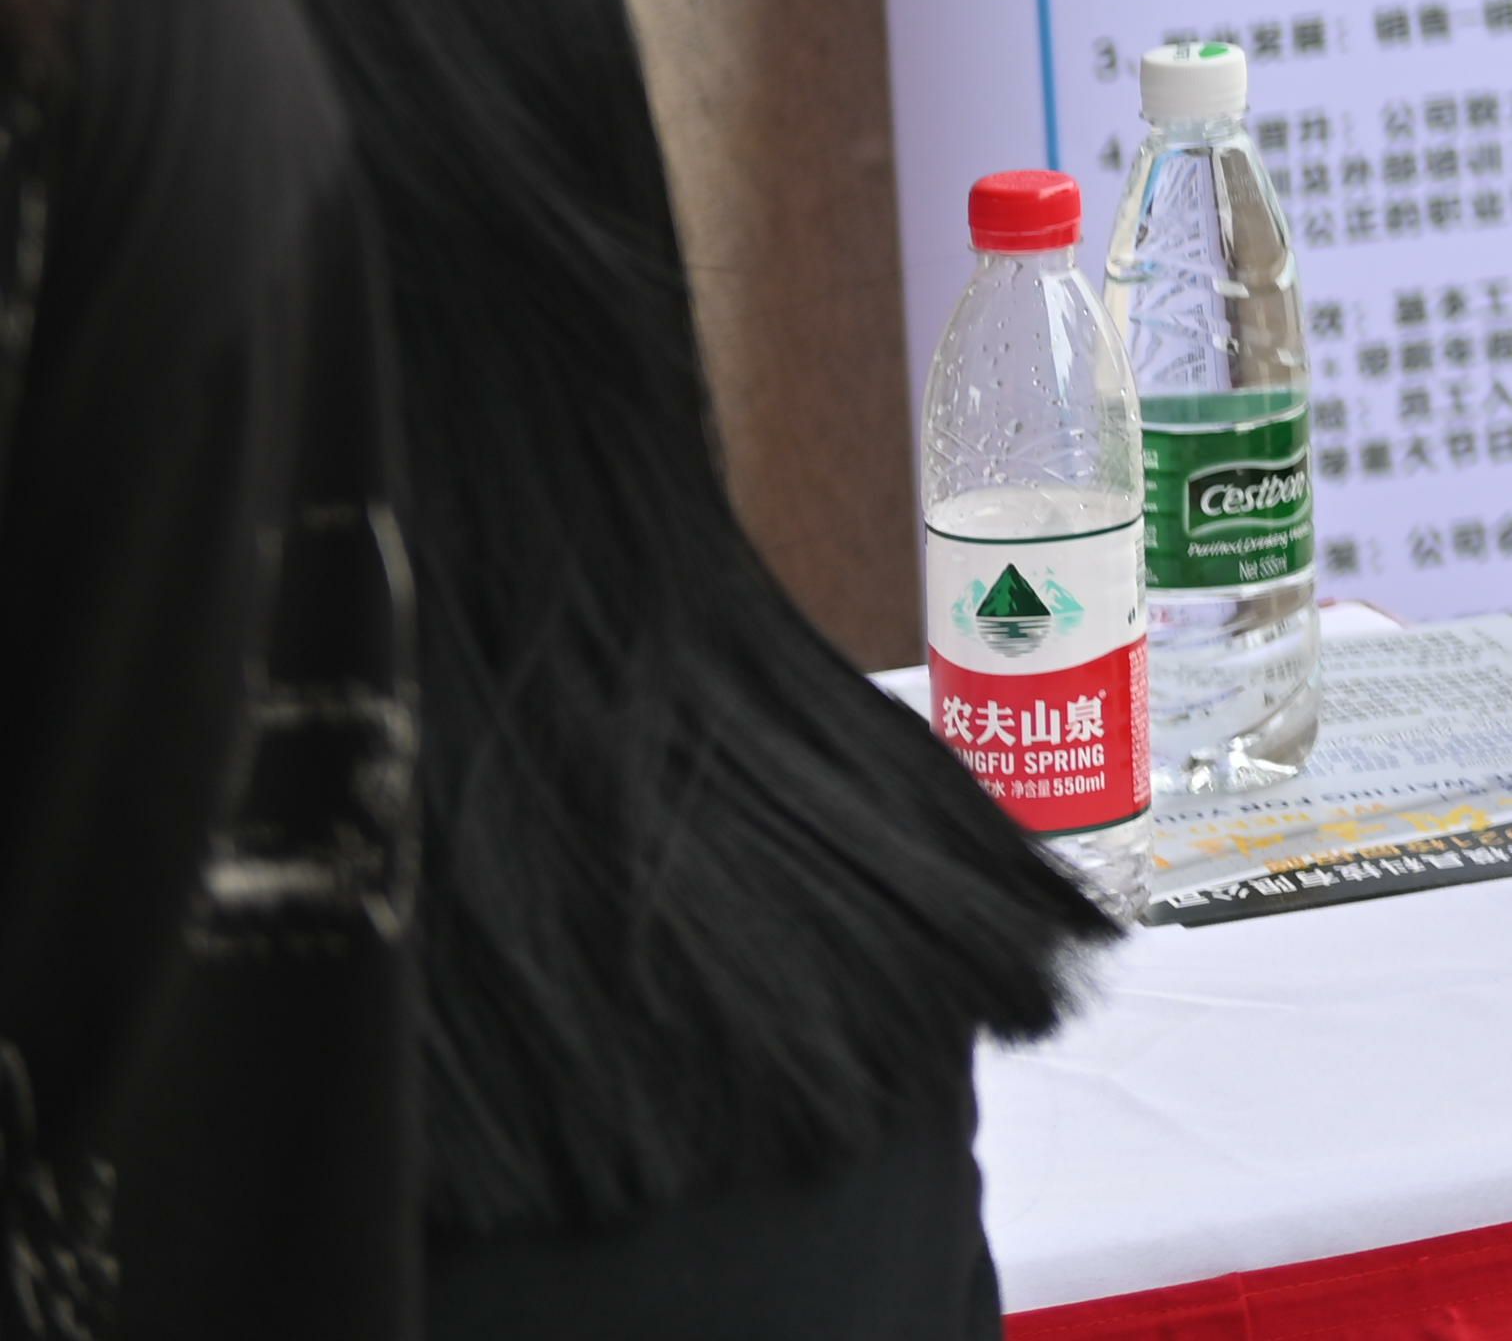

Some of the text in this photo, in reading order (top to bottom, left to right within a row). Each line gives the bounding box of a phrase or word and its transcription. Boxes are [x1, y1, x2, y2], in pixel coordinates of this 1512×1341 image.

[942, 693, 1106, 748] 农夫山泉
[953, 743, 1106, 775] NGFU SPRING
